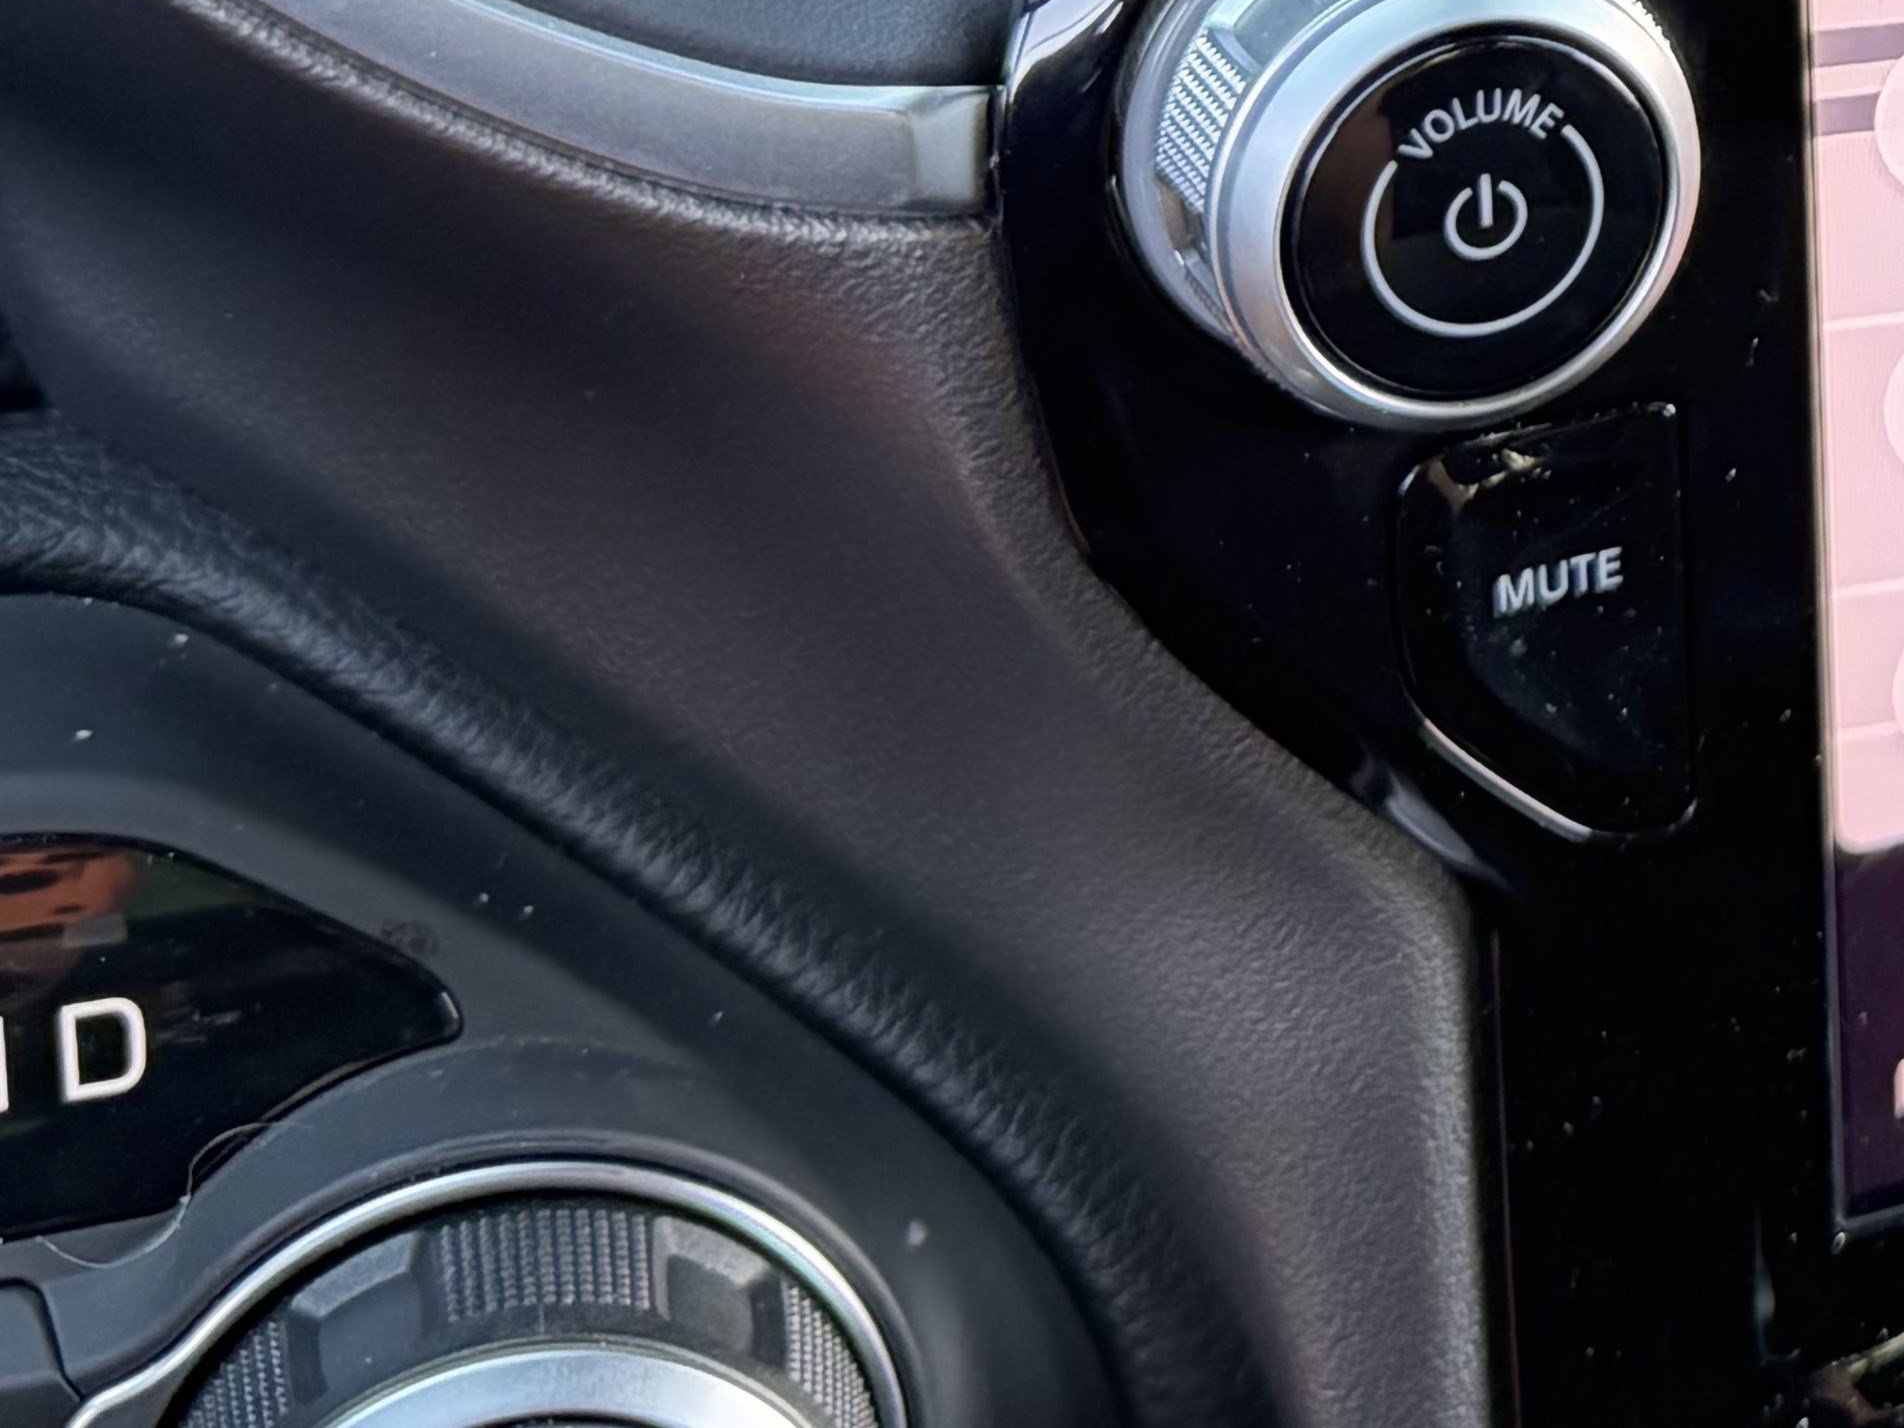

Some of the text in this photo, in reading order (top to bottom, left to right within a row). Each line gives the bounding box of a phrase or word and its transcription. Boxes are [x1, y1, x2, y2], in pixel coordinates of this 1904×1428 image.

[1397, 88, 1565, 161] VOLUME
[1493, 546, 1623, 618] MUTE
[60, 997, 147, 1104] D
